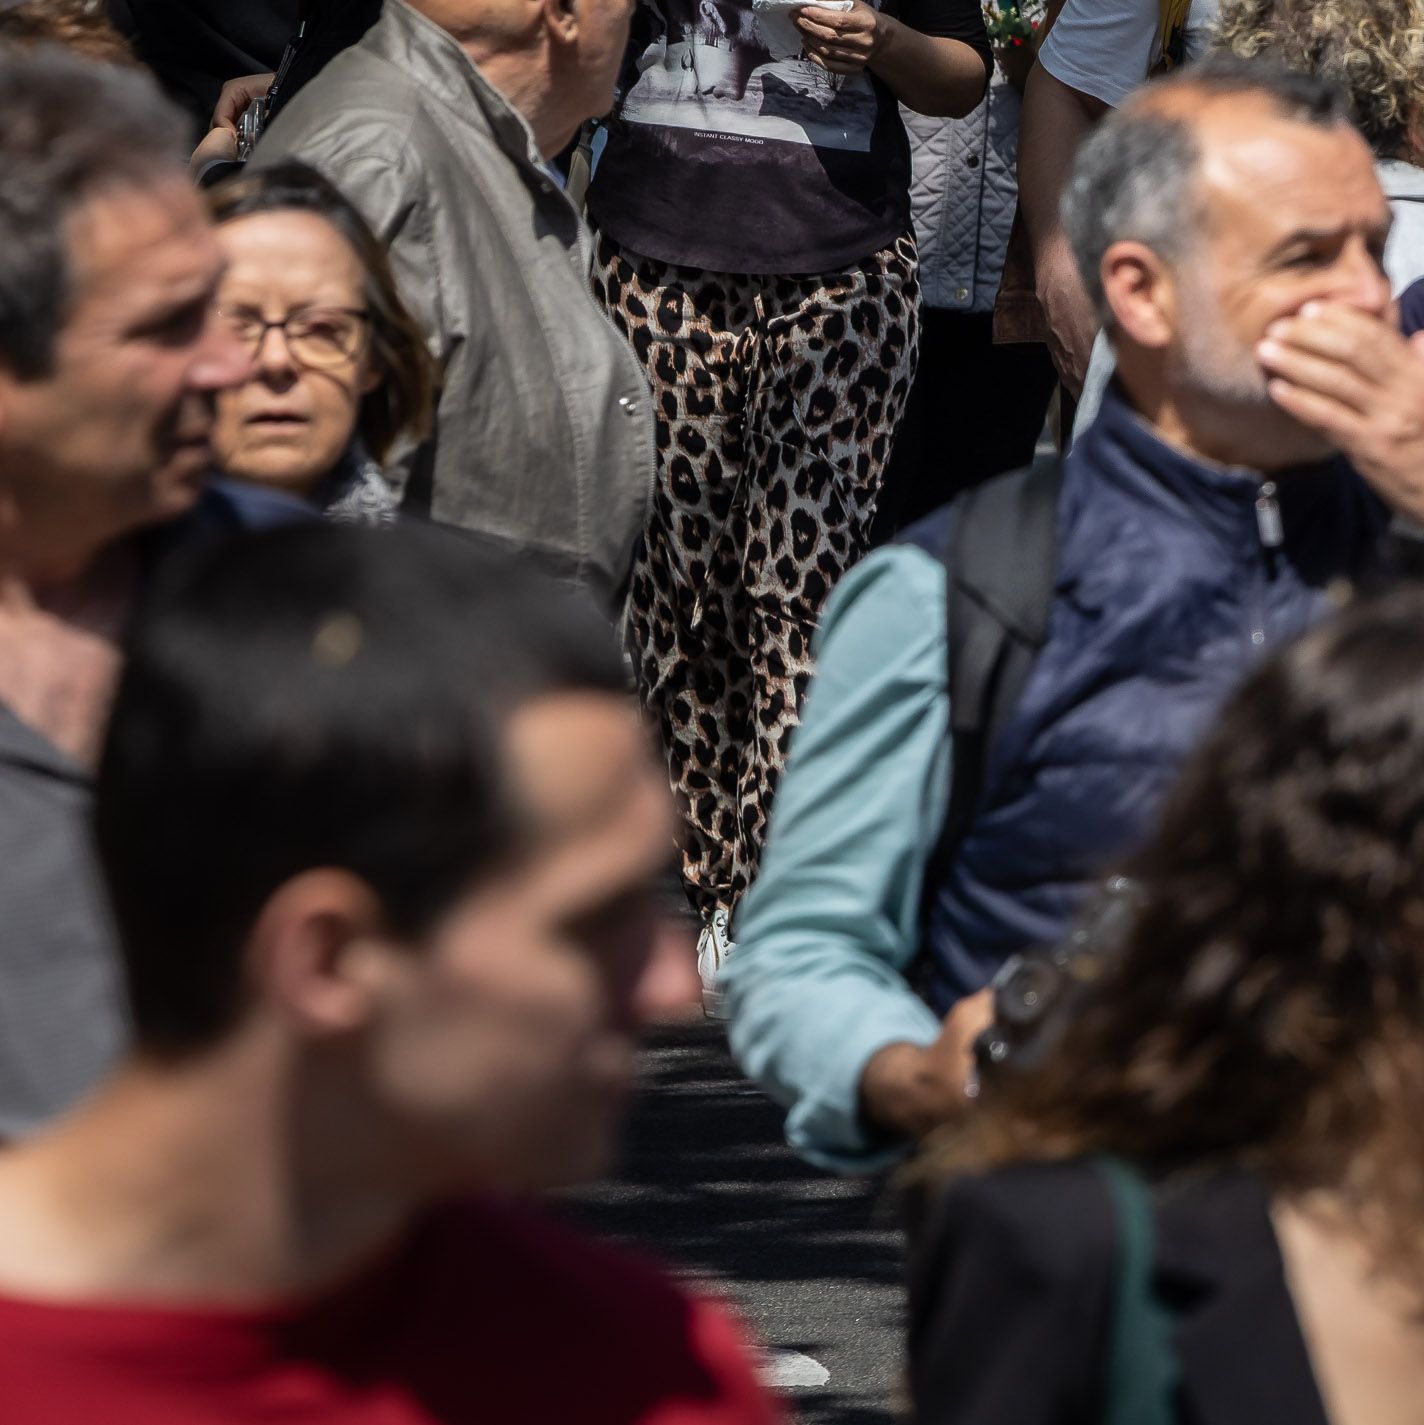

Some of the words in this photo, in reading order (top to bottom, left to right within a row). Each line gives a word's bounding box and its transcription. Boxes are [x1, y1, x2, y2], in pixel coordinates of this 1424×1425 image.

[693, 131, 718, 139] INSTANT
[719, 134, 743, 142] CLASSY
[744, 137, 764, 145] MOOD
